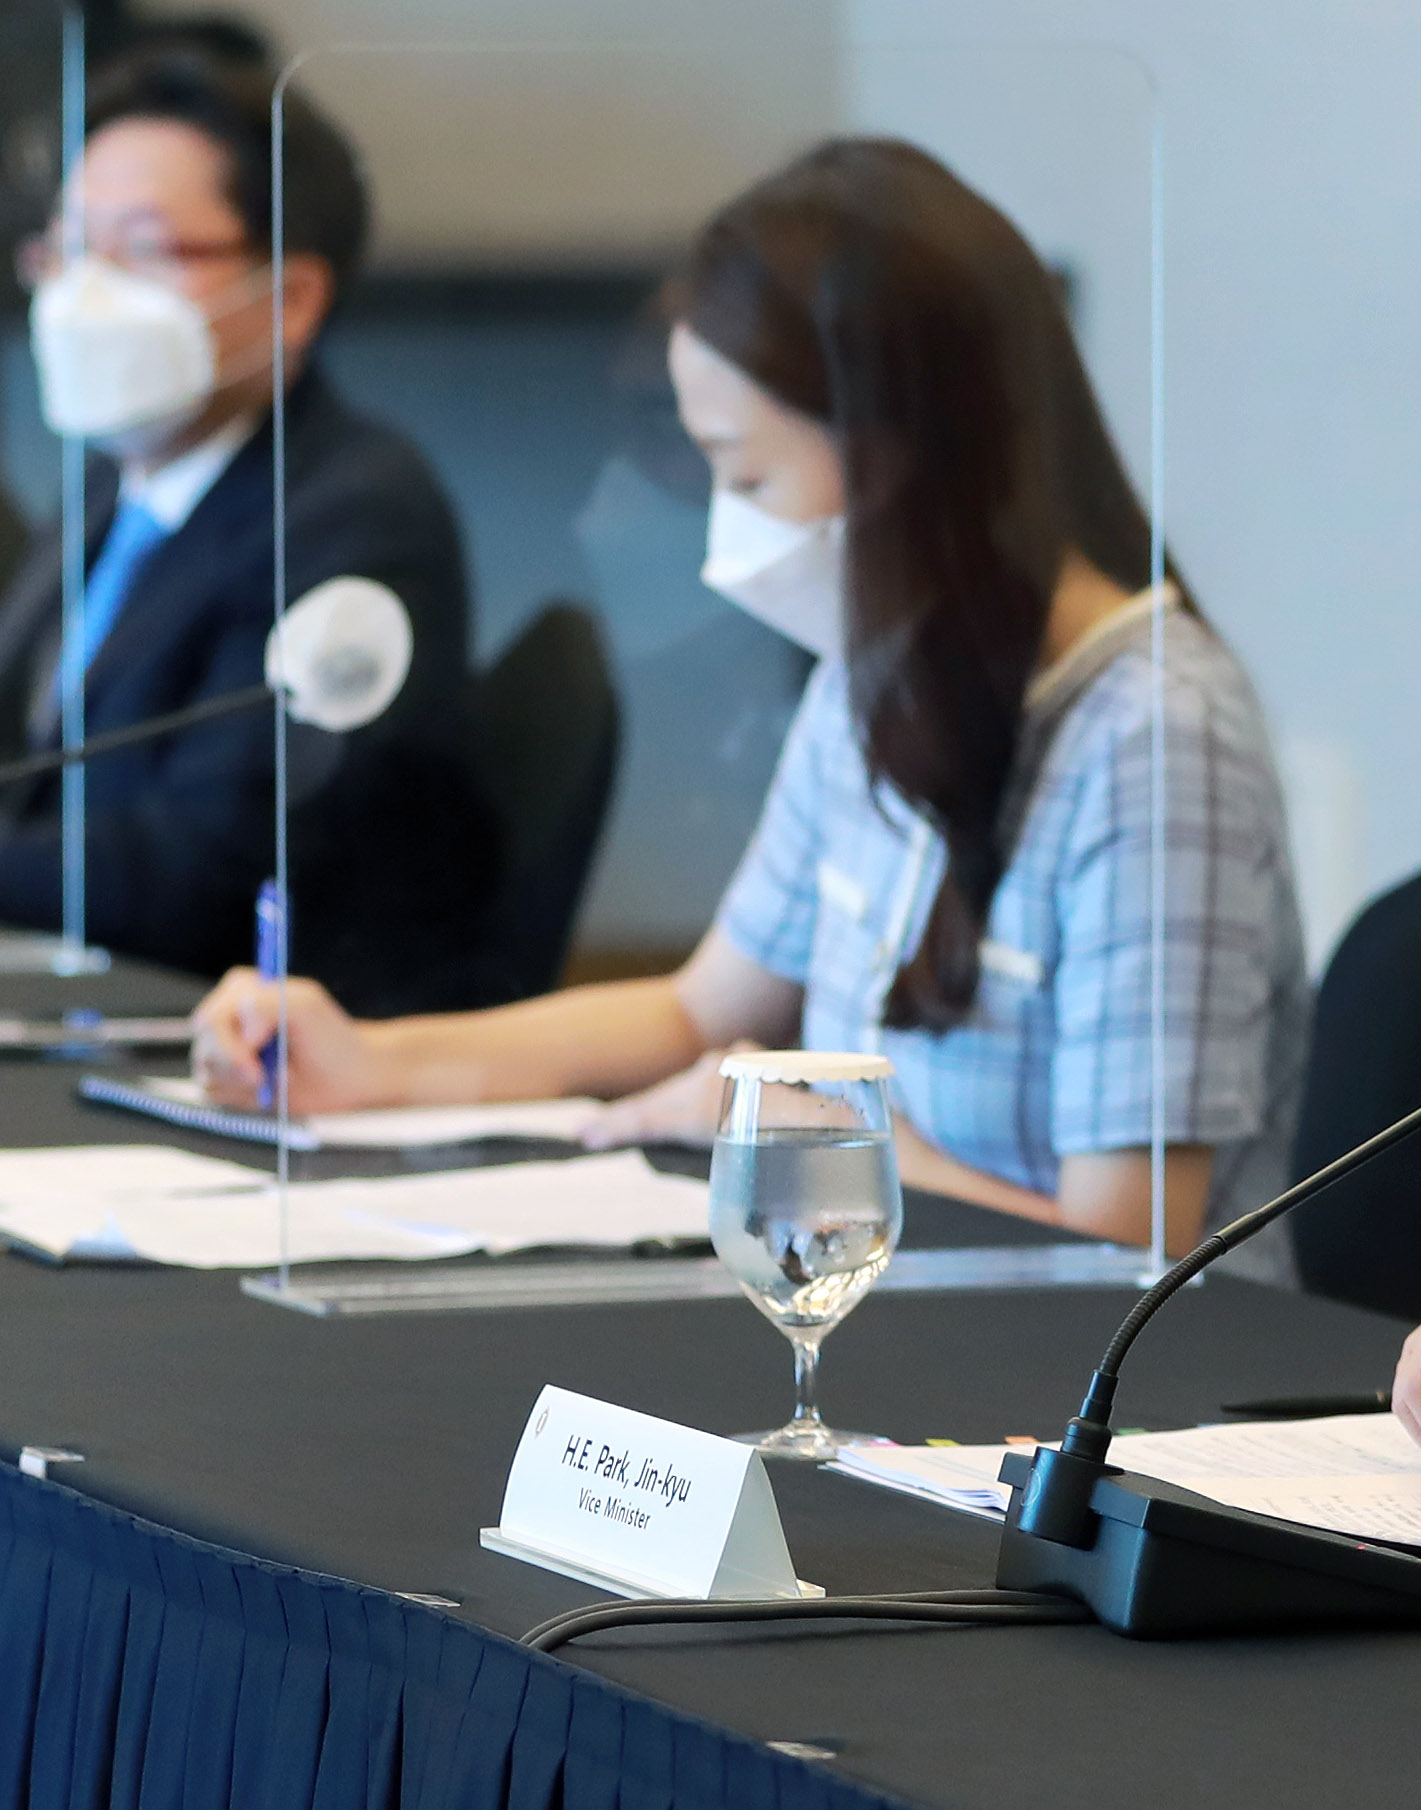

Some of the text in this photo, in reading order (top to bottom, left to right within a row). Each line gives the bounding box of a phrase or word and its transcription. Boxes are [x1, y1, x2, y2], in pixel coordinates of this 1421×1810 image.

[561, 1434, 692, 1508] H.E. Park, Jin-kyu
[578, 1487, 651, 1530] Vice Minister
